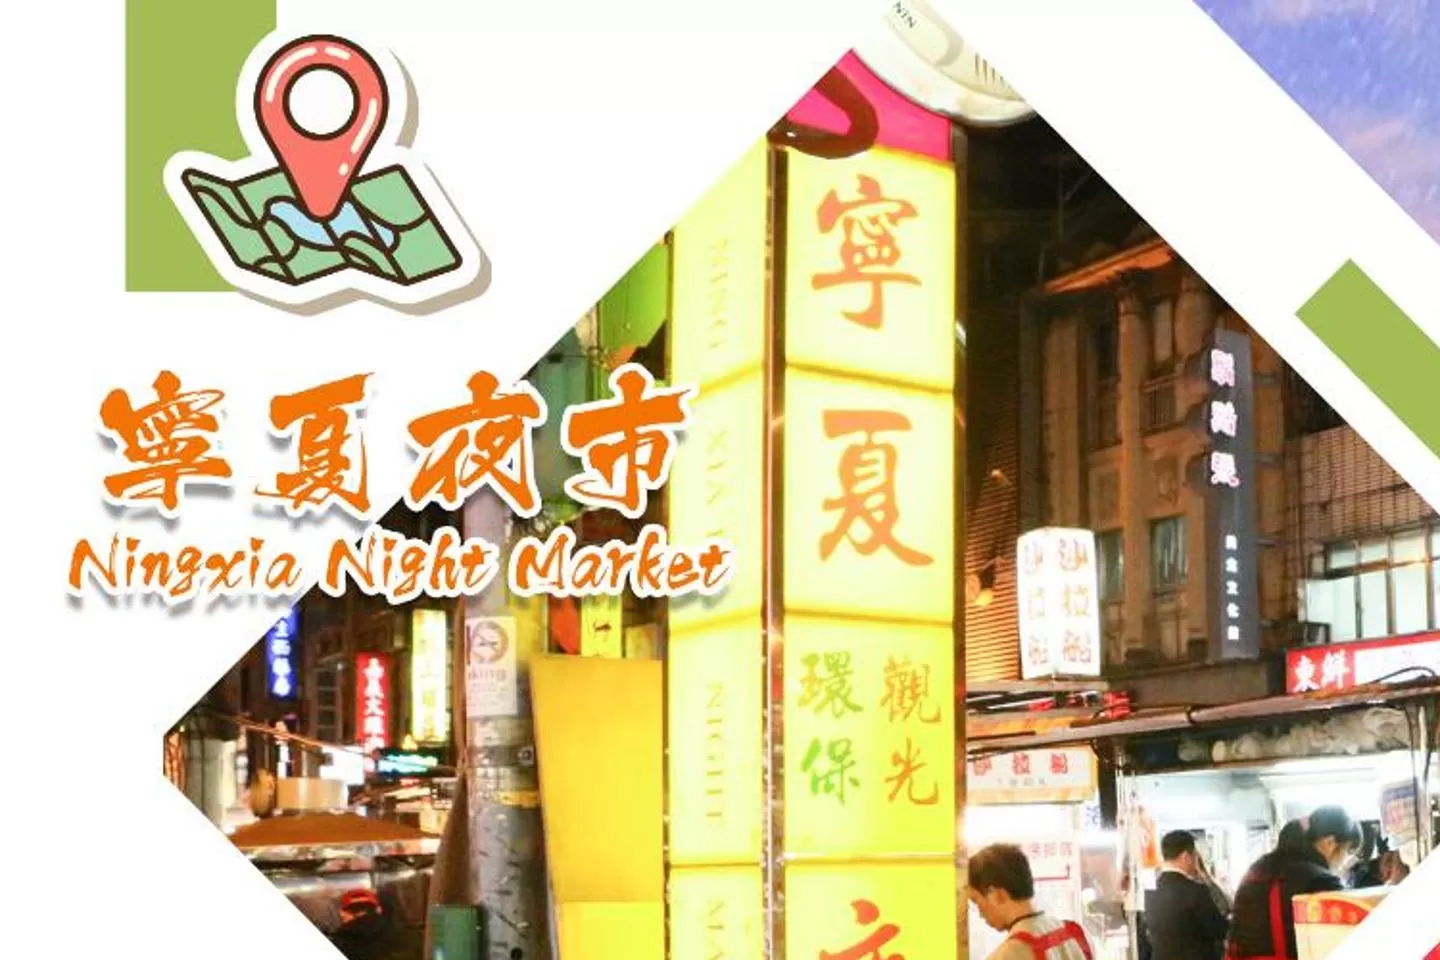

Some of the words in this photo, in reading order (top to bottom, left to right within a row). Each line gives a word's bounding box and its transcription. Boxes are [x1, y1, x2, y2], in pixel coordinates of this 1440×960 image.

[812, 174, 934, 566] 寧夏
[797, 651, 863, 805] 環保
[880, 655, 941, 805] 觀光
